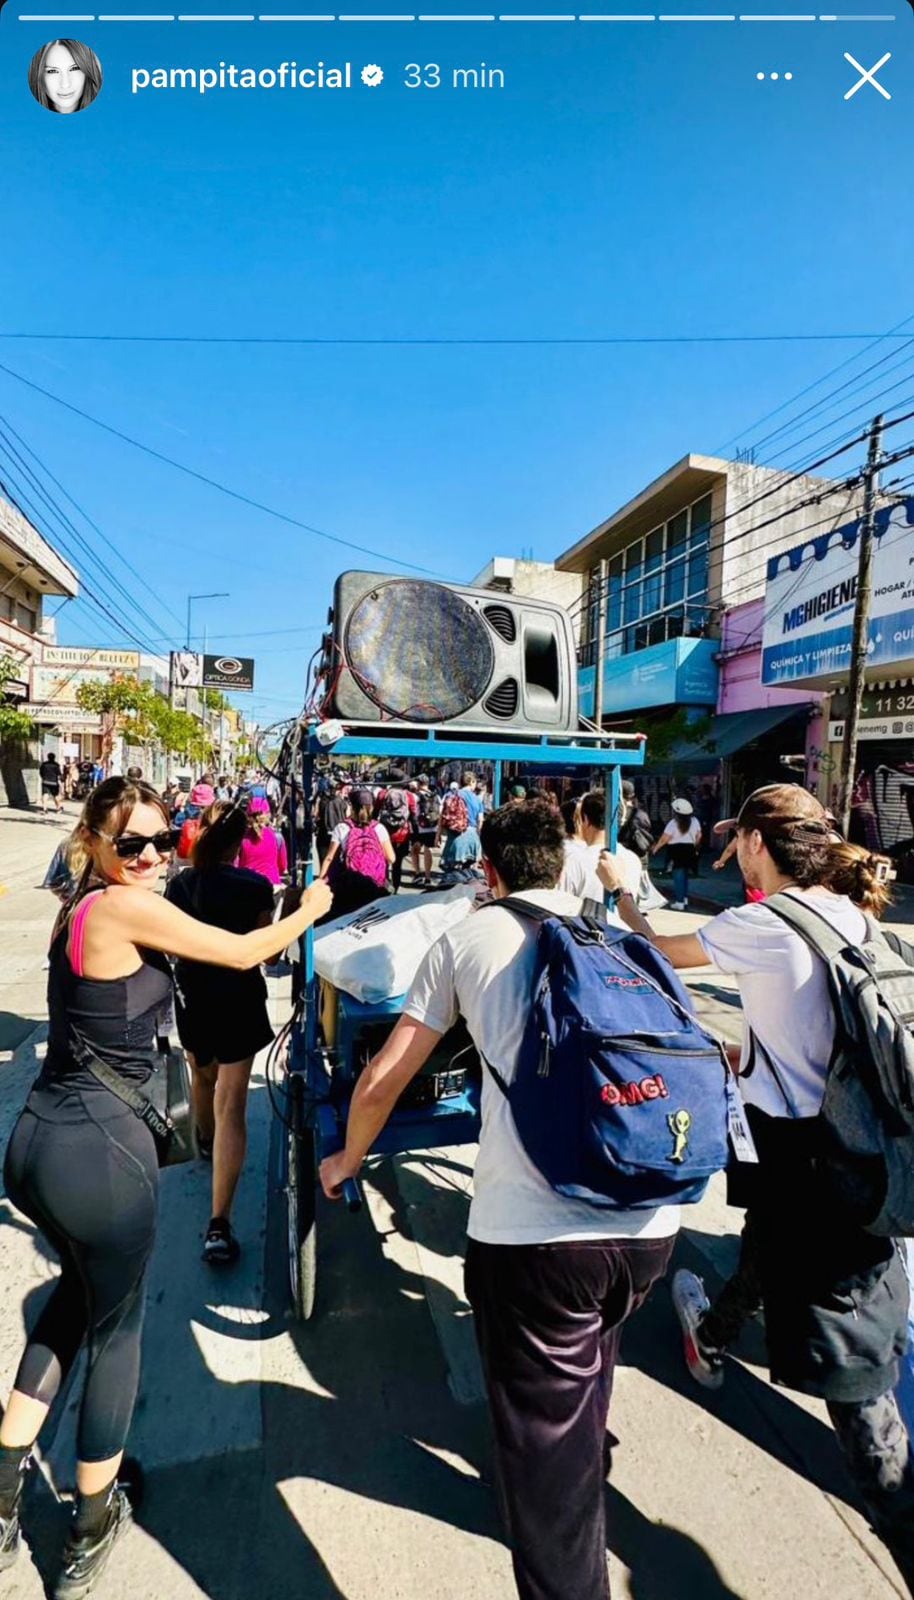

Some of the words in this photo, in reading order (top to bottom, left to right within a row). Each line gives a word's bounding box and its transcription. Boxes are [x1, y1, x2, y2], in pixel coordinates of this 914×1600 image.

[874, 581, 905, 597] HOGAR
[782, 575, 859, 634] MGHIGIENE
[770, 655, 804, 670] QUÍMICA
[805, 653, 811, 662] Y
[811, 643, 852, 660] LIMPIEZA
[875, 697, 892, 712] 11
[896, 695, 914, 710] 32
[600, 1073, 670, 1106] OMG!
